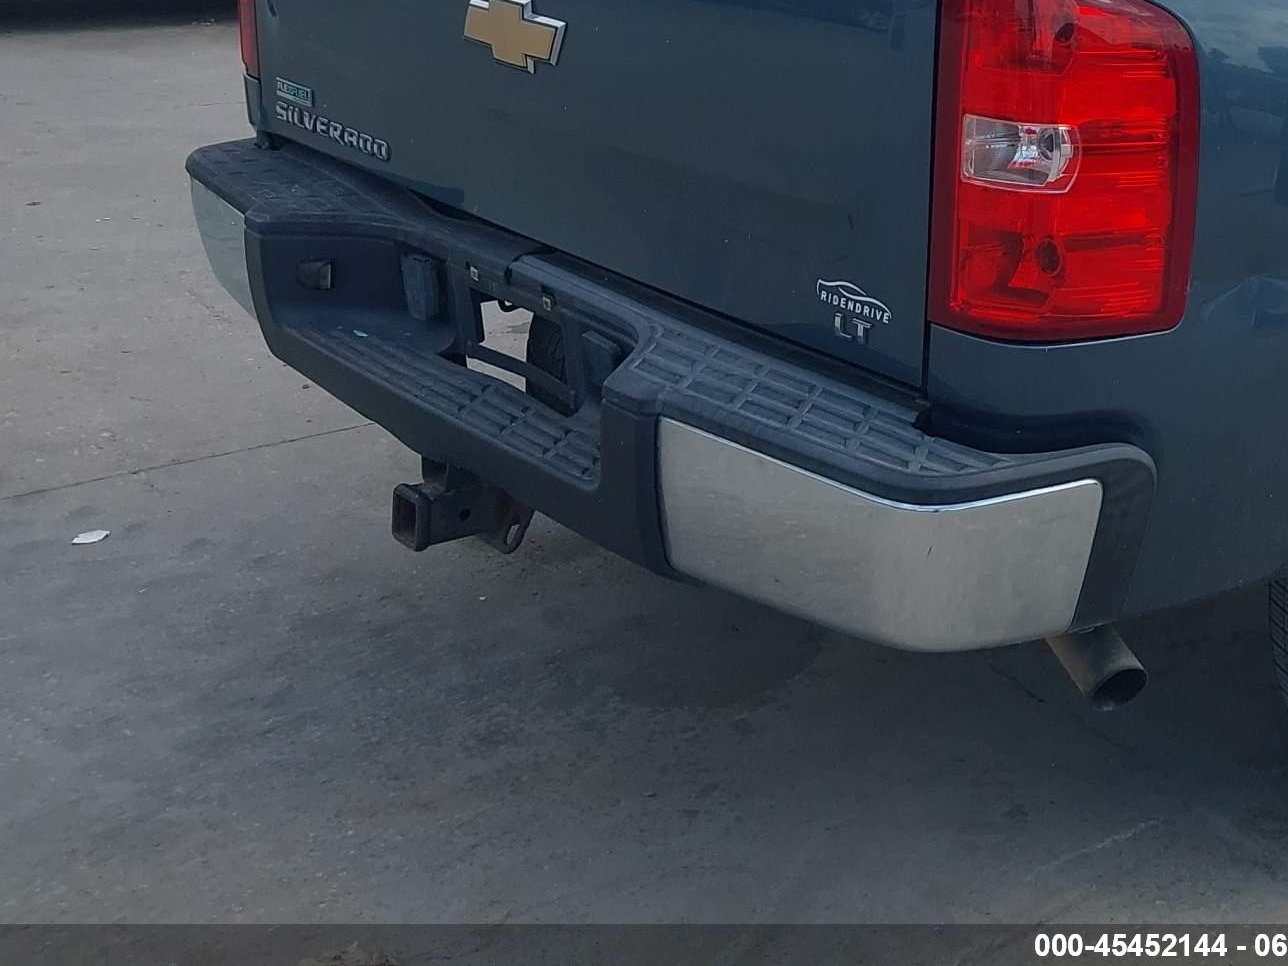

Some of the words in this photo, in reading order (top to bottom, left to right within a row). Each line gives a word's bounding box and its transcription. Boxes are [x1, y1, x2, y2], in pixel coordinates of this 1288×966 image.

[275, 101, 391, 162] SILVERADO
[820, 290, 890, 324] RIDENDRIVE
[834, 312, 872, 345] LT
